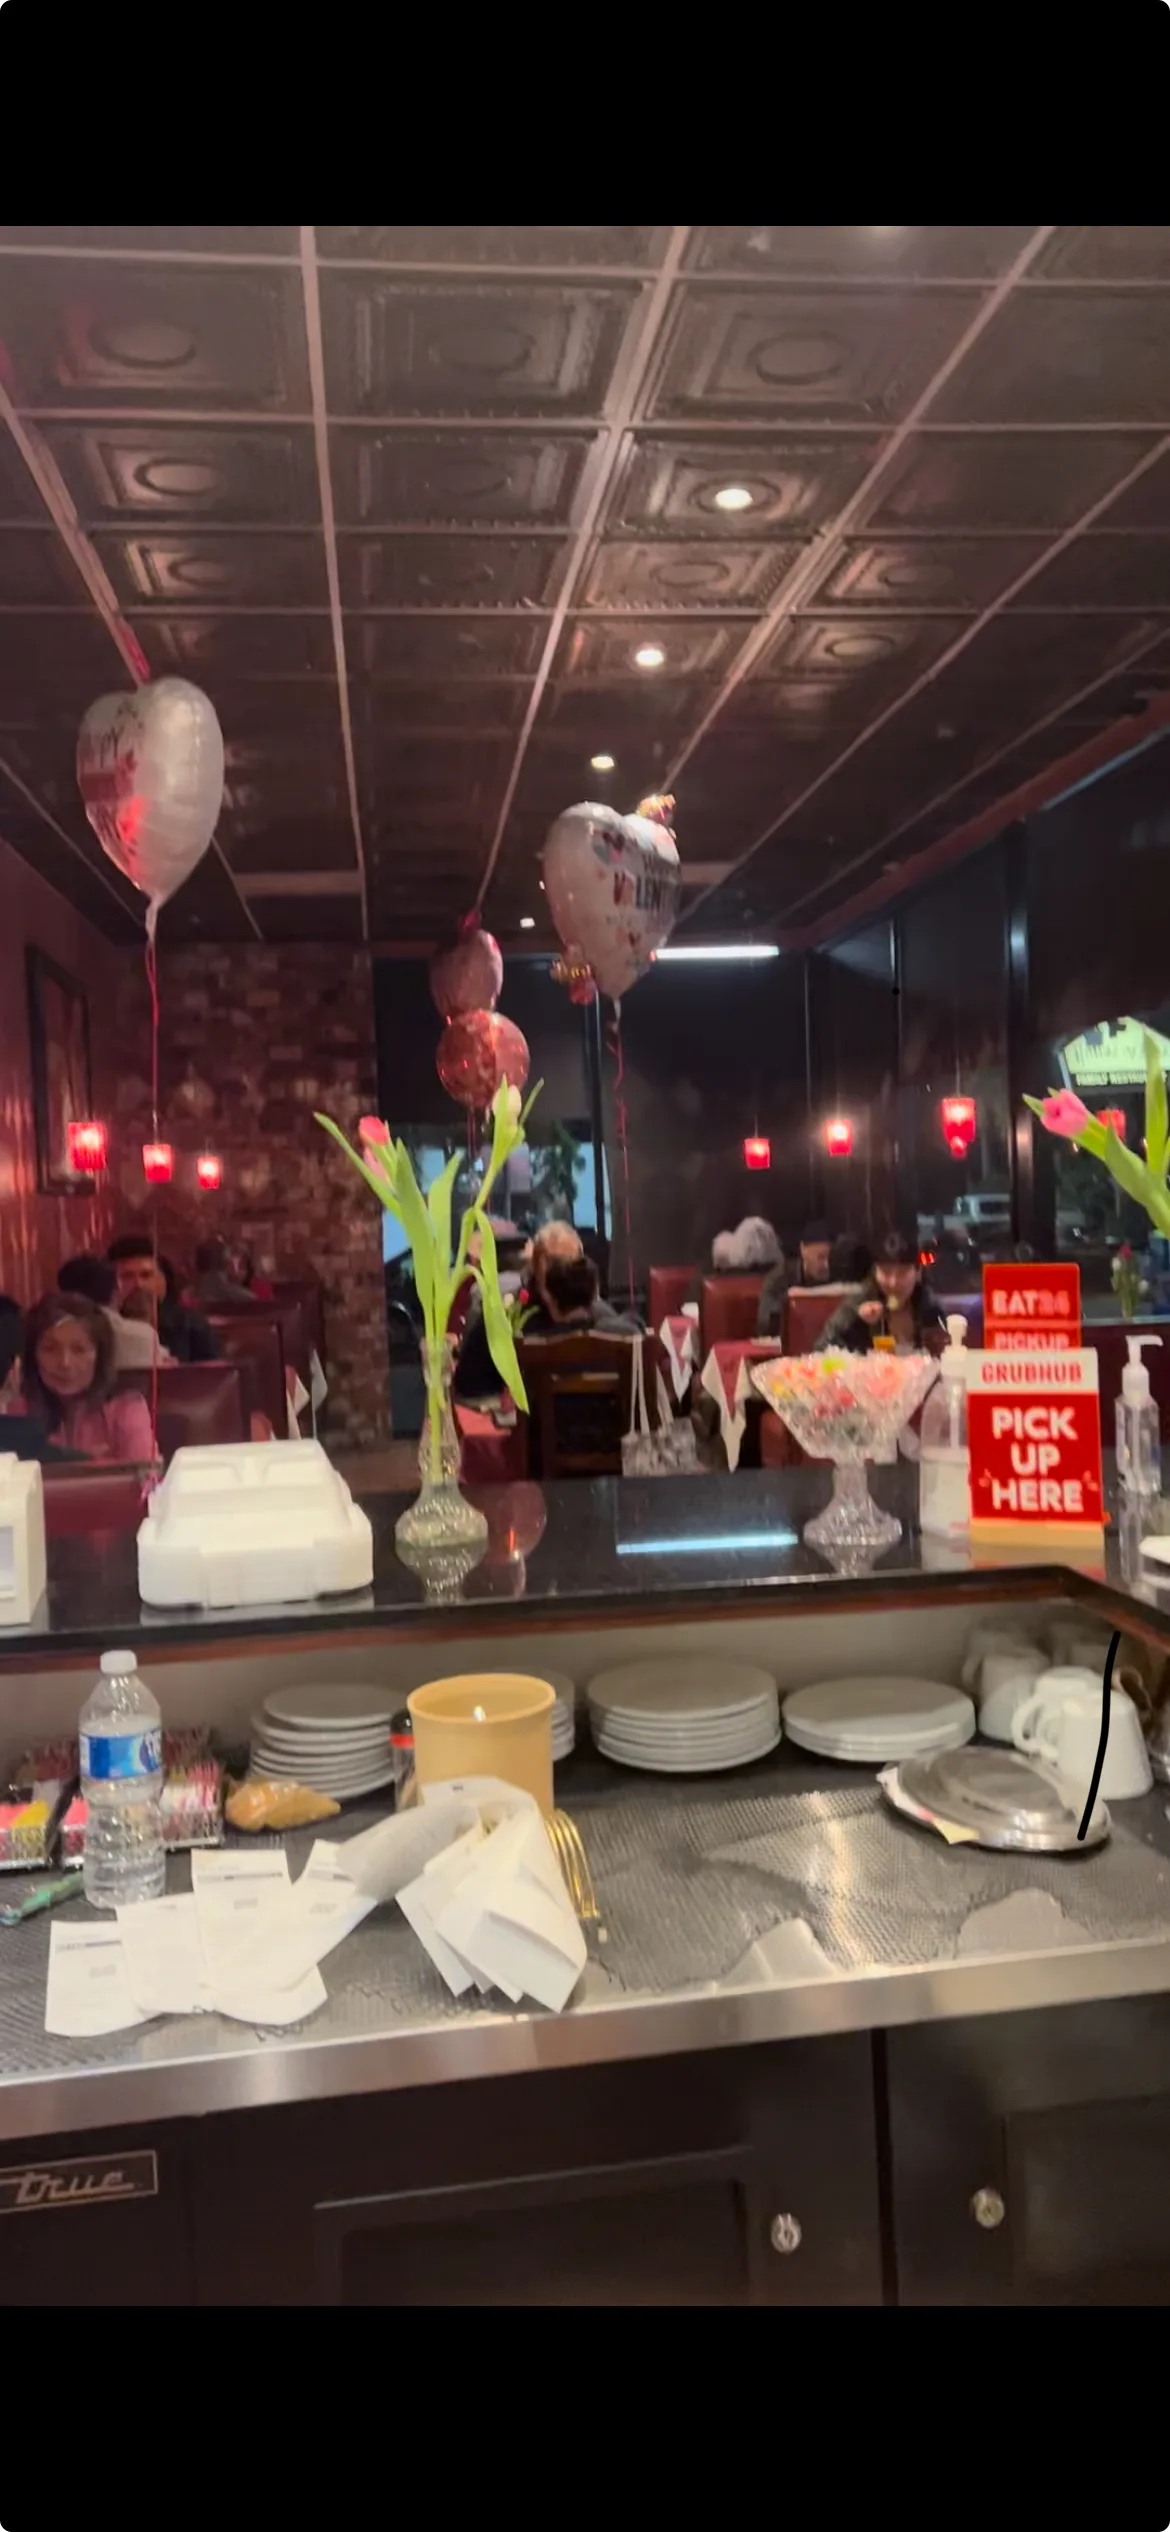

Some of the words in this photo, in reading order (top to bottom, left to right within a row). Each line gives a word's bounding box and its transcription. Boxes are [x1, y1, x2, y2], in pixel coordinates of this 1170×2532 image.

[991, 1288, 1071, 1315] EAT24
[993, 1331, 1070, 1350] PICKUP
[981, 1361, 1083, 1384] GRUBHUB
[991, 1407, 1078, 1441] PICK
[1010, 1443, 1061, 1475] UP
[990, 1481, 1084, 1513] HERE
